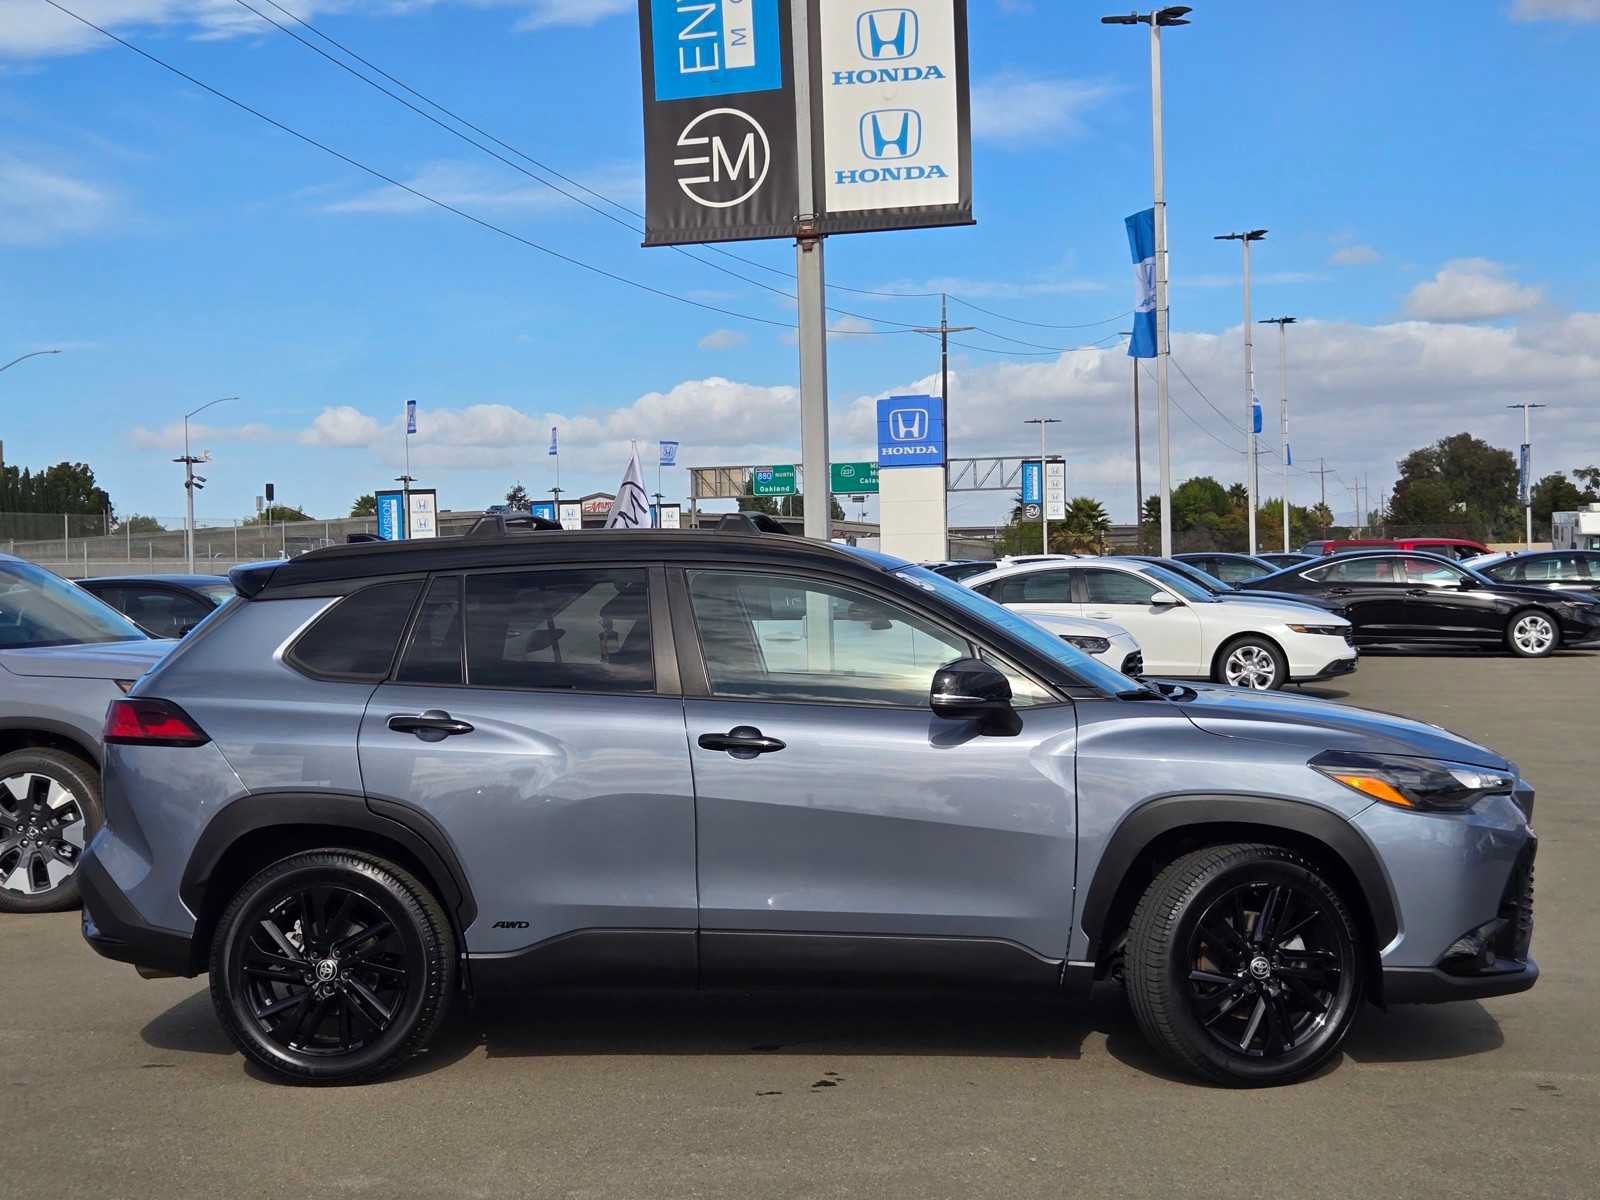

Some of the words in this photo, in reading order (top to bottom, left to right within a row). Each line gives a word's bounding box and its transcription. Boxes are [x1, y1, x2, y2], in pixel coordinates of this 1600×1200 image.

[677, 0, 719, 73] EN
[832, 65, 946, 85] HONDA
[835, 165, 948, 184] HONDA
[881, 446, 938, 456] HONDA
[758, 472, 772, 480] 880
[491, 920, 530, 929] AWD
